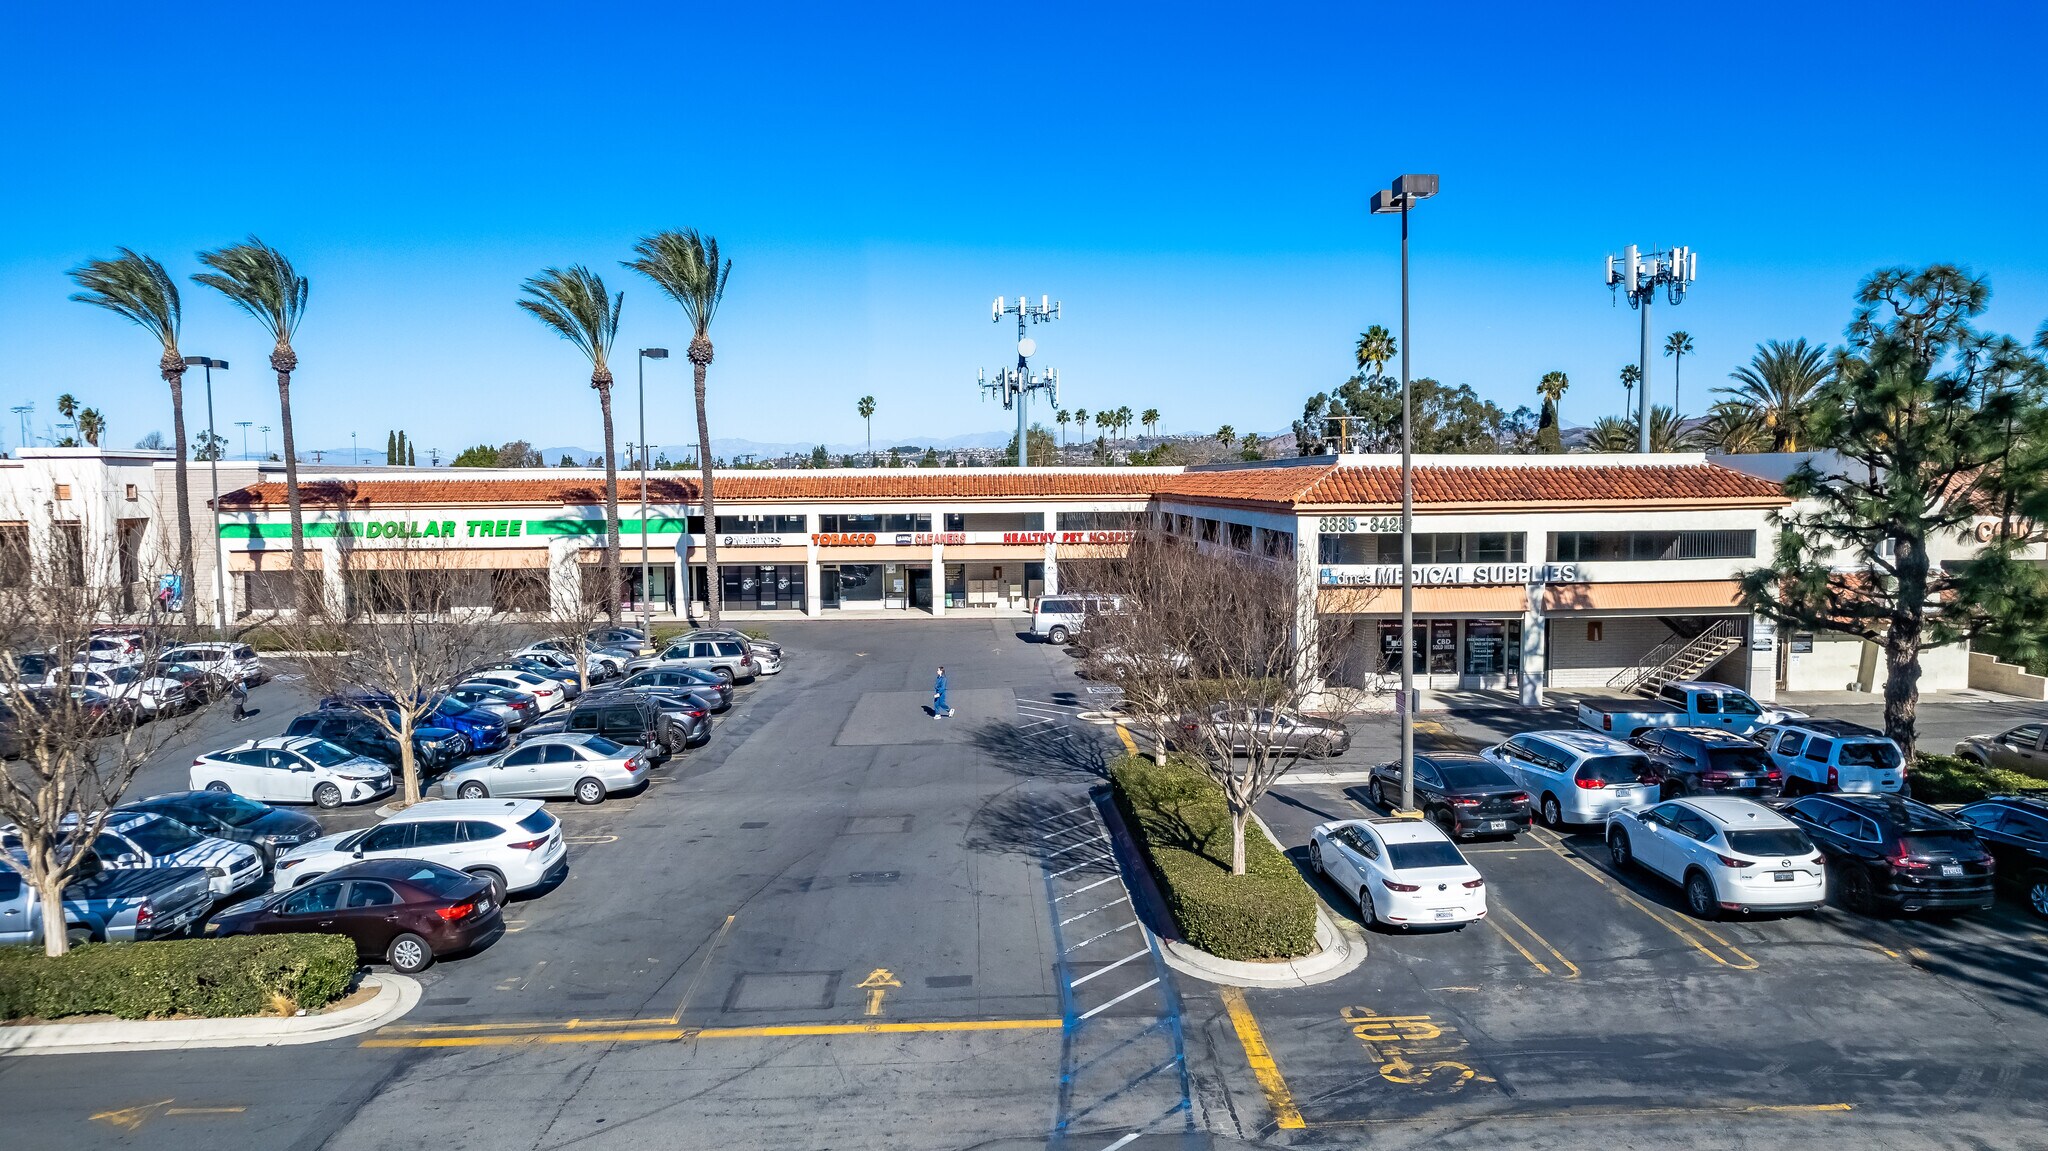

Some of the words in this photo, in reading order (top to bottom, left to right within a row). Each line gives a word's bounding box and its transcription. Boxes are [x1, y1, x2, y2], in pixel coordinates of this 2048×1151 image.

[366, 521, 456, 538] DOLLAR
[467, 520, 523, 537] TREE
[733, 536, 782, 546] MARINES
[811, 533, 877, 547] TOBACCO
[915, 532, 966, 545] CLEANERS
[1003, 532, 1056, 543] HEALTHY
[1062, 532, 1084, 543] PET
[1375, 566, 1469, 584] MEDICAL
[1474, 565, 1576, 583] SUPPLIES
